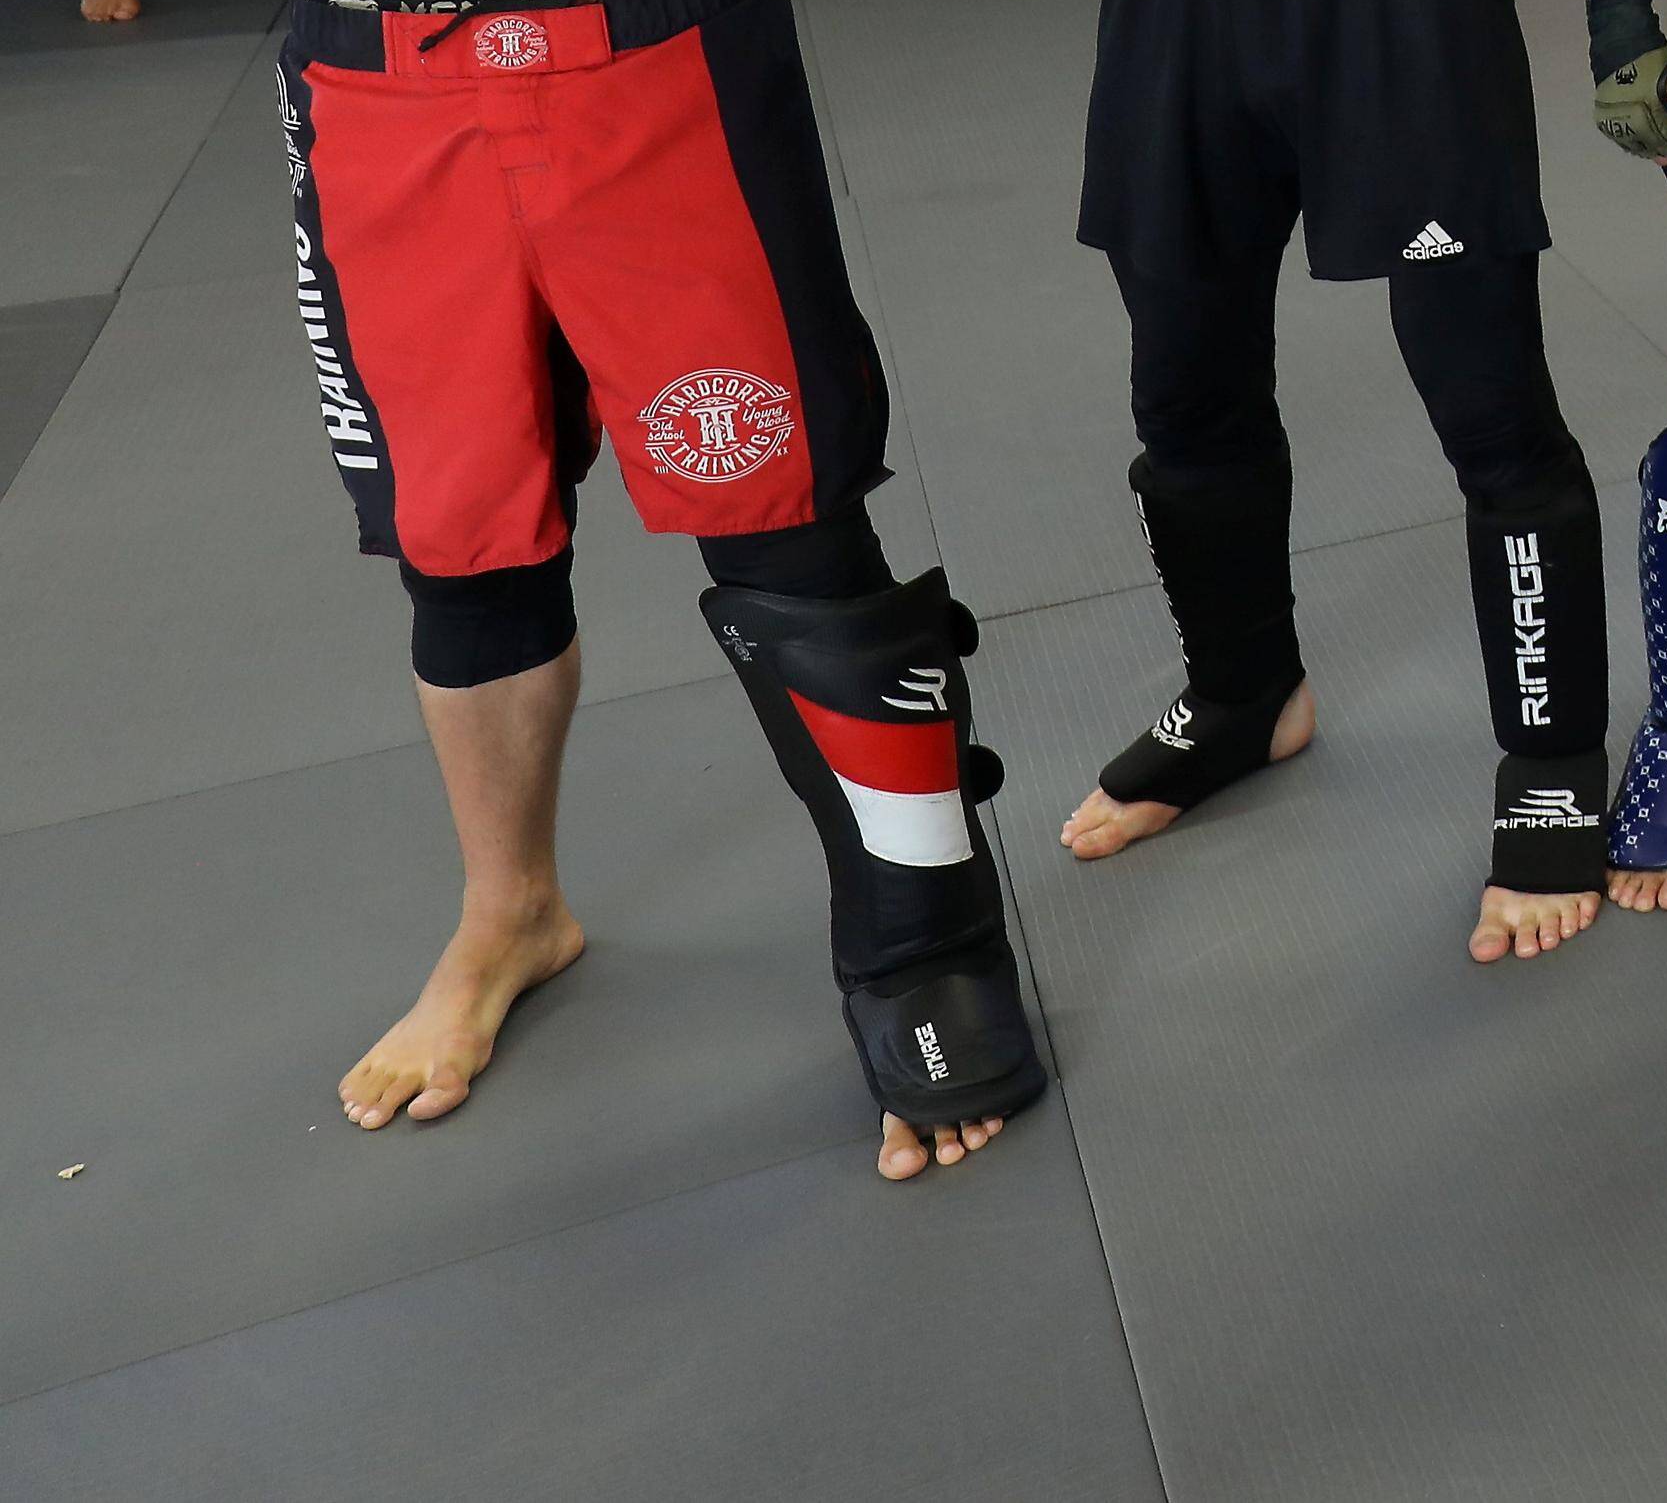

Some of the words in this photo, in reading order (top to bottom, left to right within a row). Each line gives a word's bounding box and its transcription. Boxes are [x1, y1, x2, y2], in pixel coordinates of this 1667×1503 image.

[1402, 240, 1464, 262] adidas
[660, 377, 766, 417] HARDCORE
[742, 405, 784, 424] Young
[757, 410, 791, 429] blood
[647, 429, 685, 441] school
[648, 420, 674, 431] Old
[671, 434, 771, 475] TRAINING
[723, 625, 740, 636] CE
[1504, 533, 1551, 726] RINKAGE
[1493, 814, 1600, 830] RINKAGE
